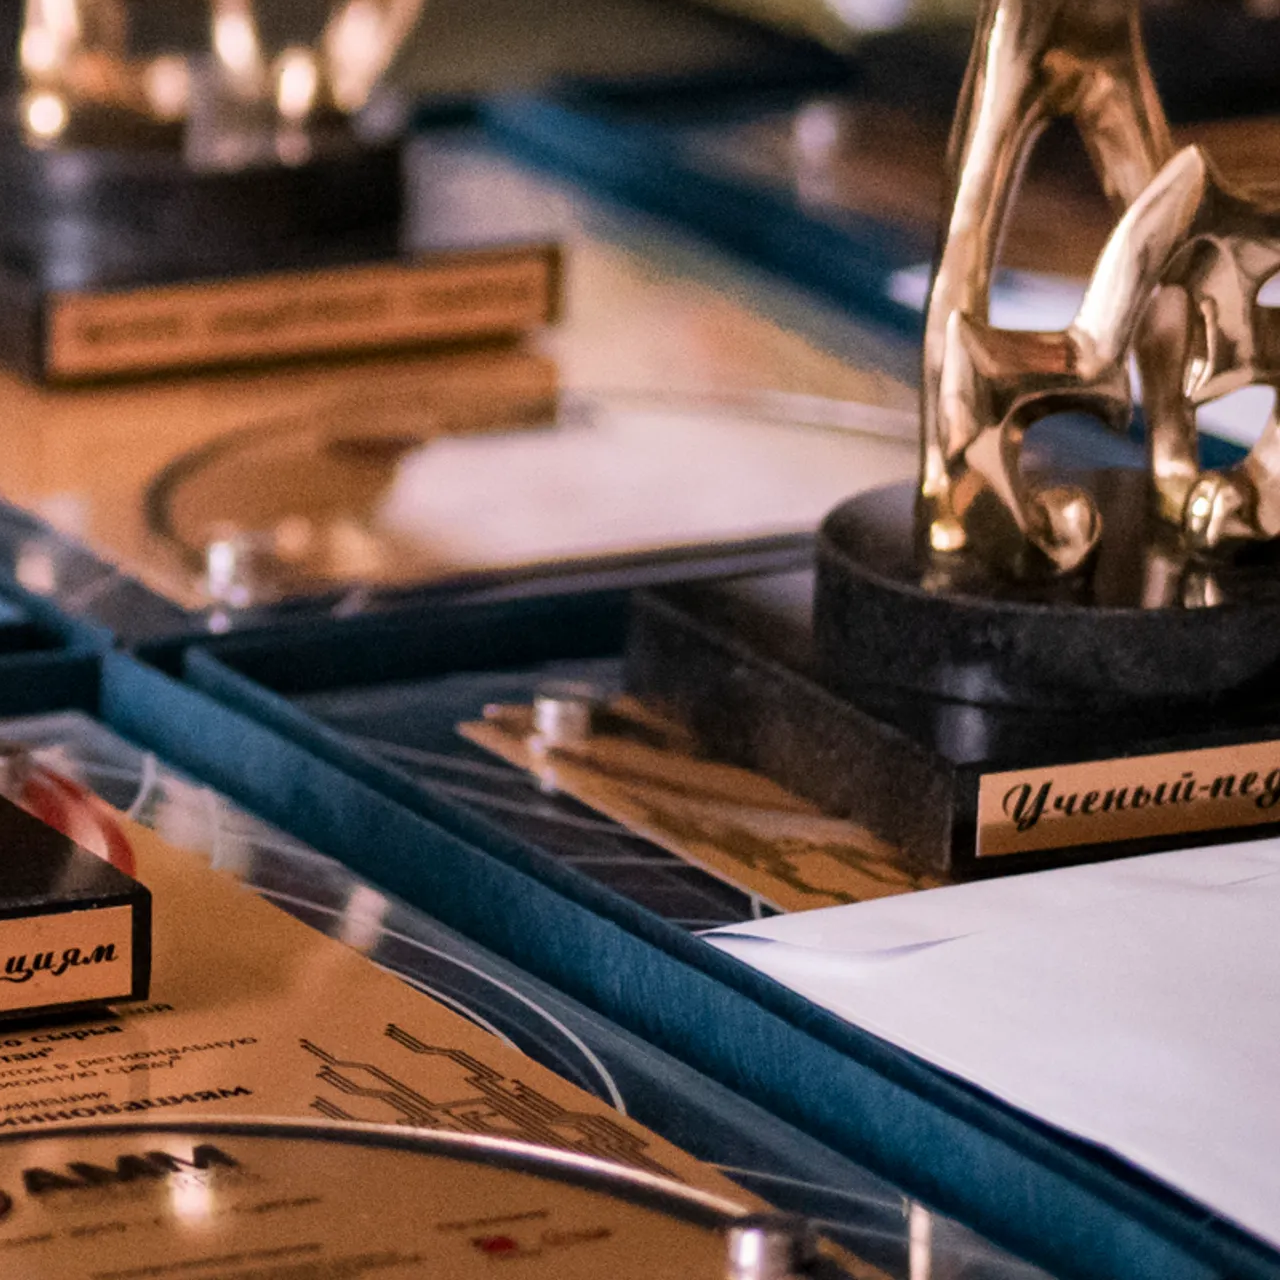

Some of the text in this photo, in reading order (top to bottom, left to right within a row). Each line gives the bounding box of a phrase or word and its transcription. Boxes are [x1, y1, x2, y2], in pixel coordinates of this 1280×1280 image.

[30, 1025, 124, 1044] сырья
[53, 1062, 69, 1071] в
[75, 1036, 258, 1068] региональную
